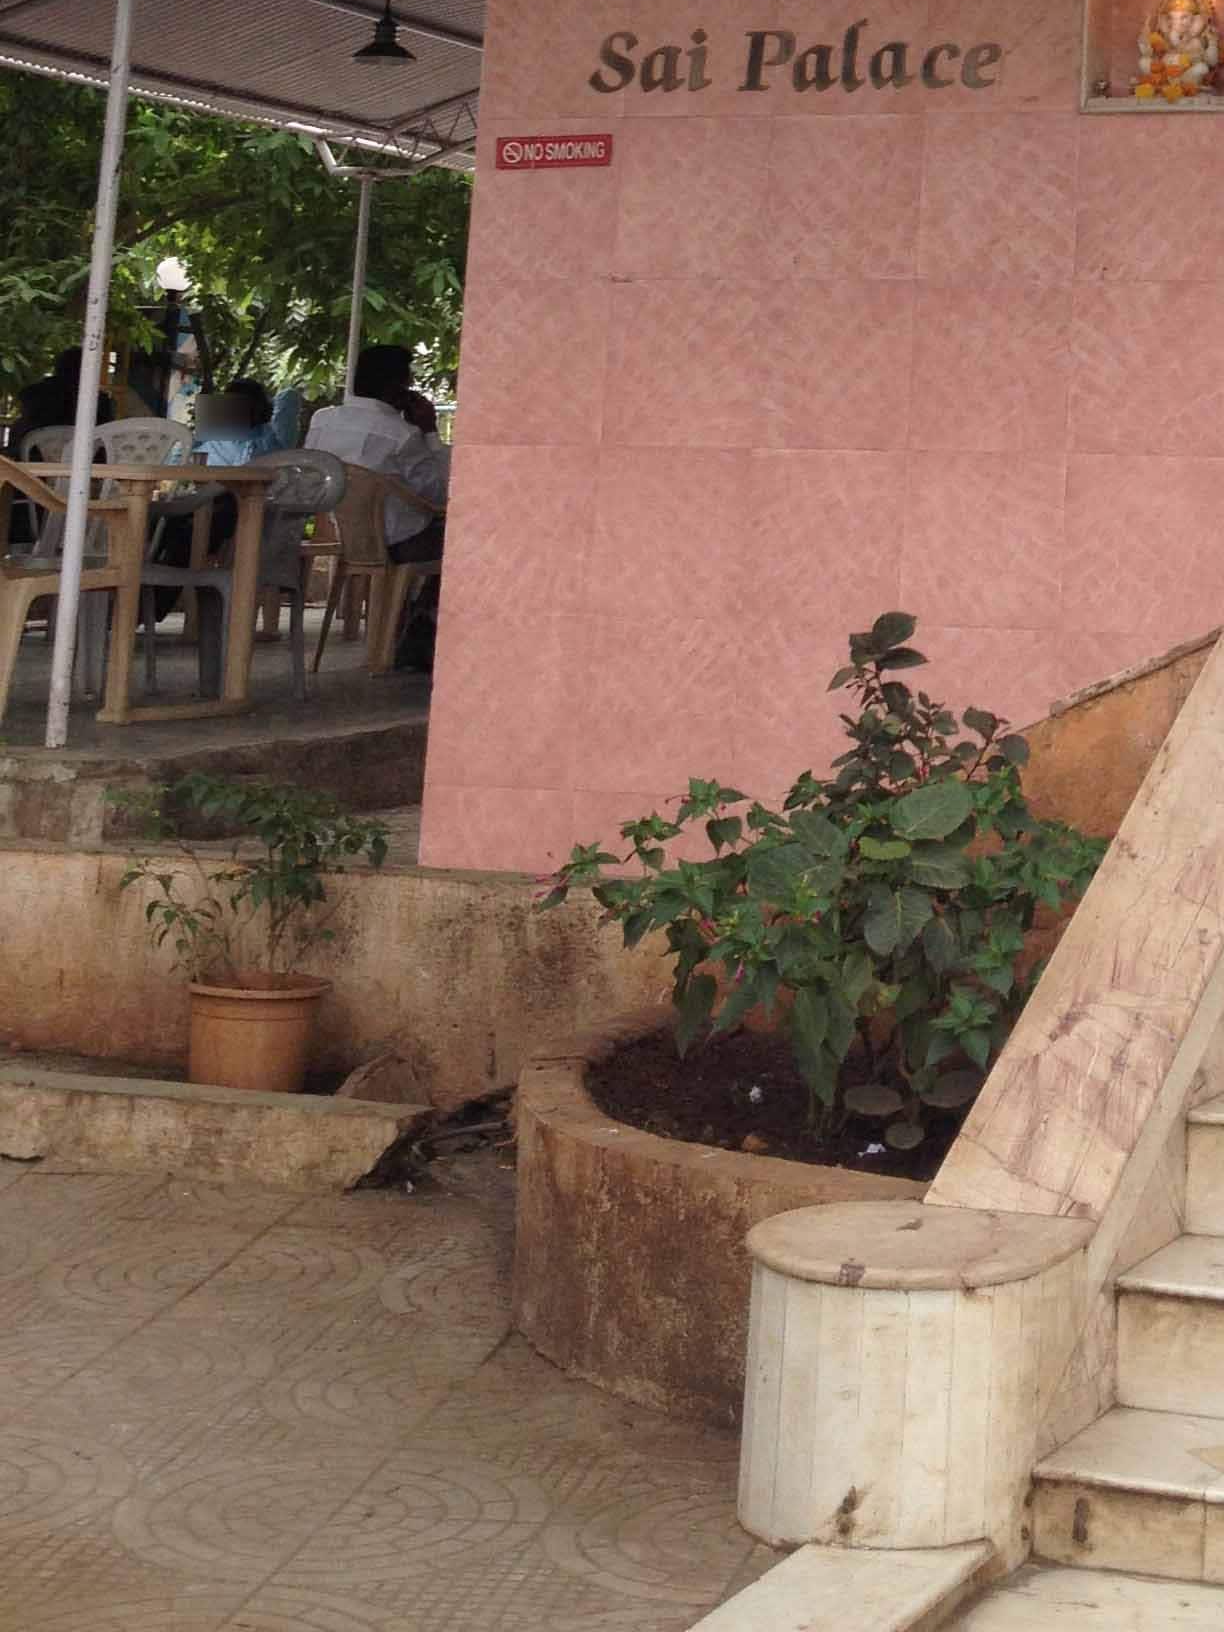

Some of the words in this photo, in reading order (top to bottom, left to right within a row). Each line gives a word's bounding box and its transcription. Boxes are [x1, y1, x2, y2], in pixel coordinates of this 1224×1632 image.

[588, 28, 713, 94] Sai
[735, 17, 1003, 93] Palace
[524, 142, 544, 161] NO
[545, 140, 606, 161] SMOKING
